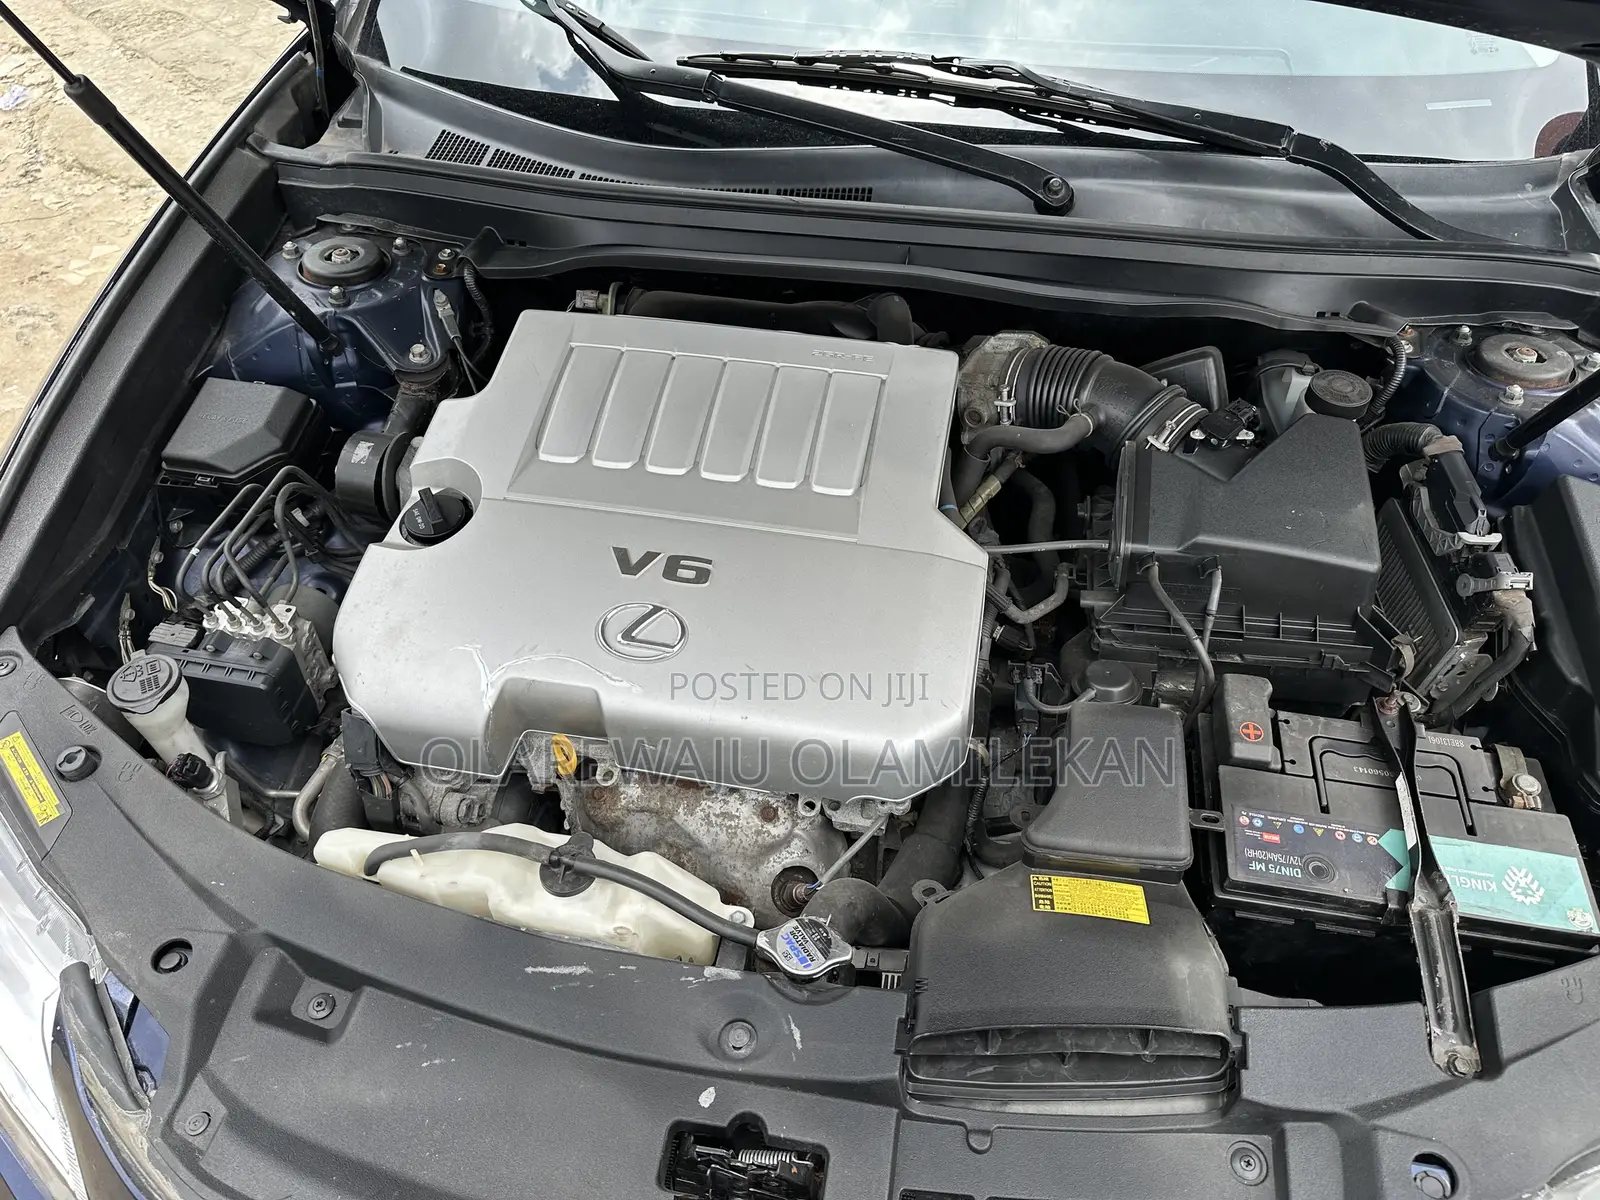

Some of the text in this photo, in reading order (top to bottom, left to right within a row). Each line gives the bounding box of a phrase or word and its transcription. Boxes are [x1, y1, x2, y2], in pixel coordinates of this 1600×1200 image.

[611, 546, 713, 586] V6
[1244, 847, 1302, 866] 12V/75Ah(20HR)
[1249, 860, 1302, 878] DIN75 MF
[792, 924, 810, 945] VALVE
[789, 930, 817, 963] RADIATOR
